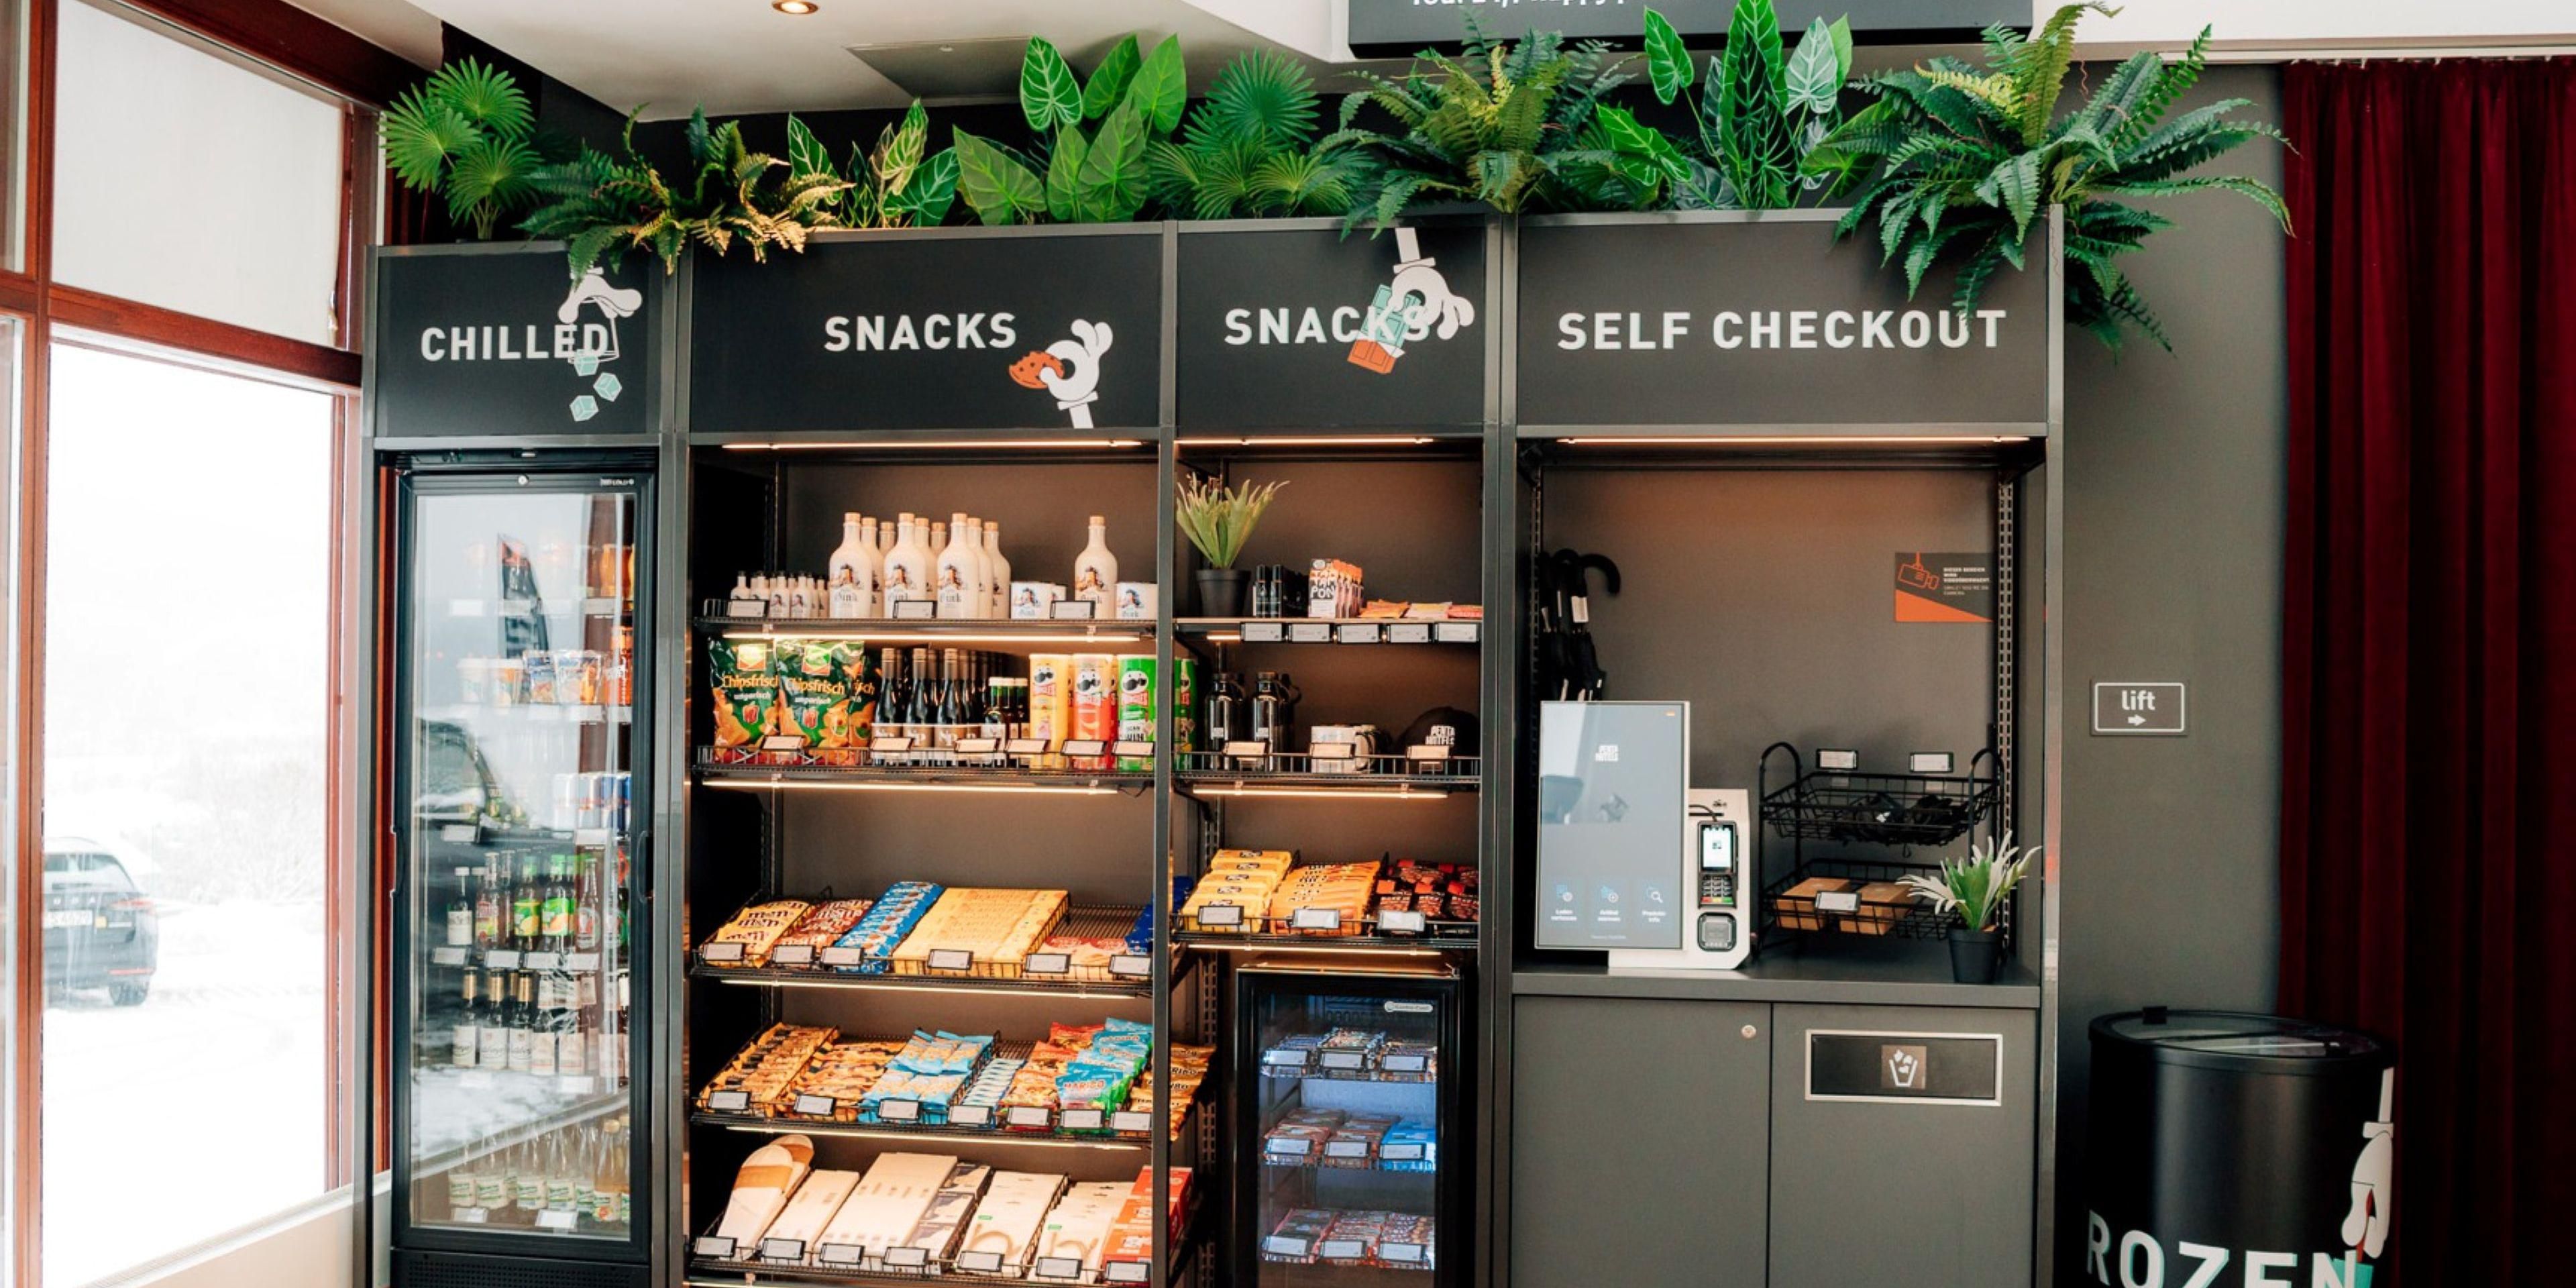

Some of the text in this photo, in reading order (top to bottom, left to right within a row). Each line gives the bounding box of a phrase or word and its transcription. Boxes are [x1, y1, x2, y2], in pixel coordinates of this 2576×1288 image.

[421, 322, 609, 361] CHILLED
[824, 312, 1016, 352] SNACKS
[1224, 305, 1430, 345] SNACKS
[1557, 309, 2006, 350] SELF CHECKOUT
[2122, 690, 2155, 710] lift
